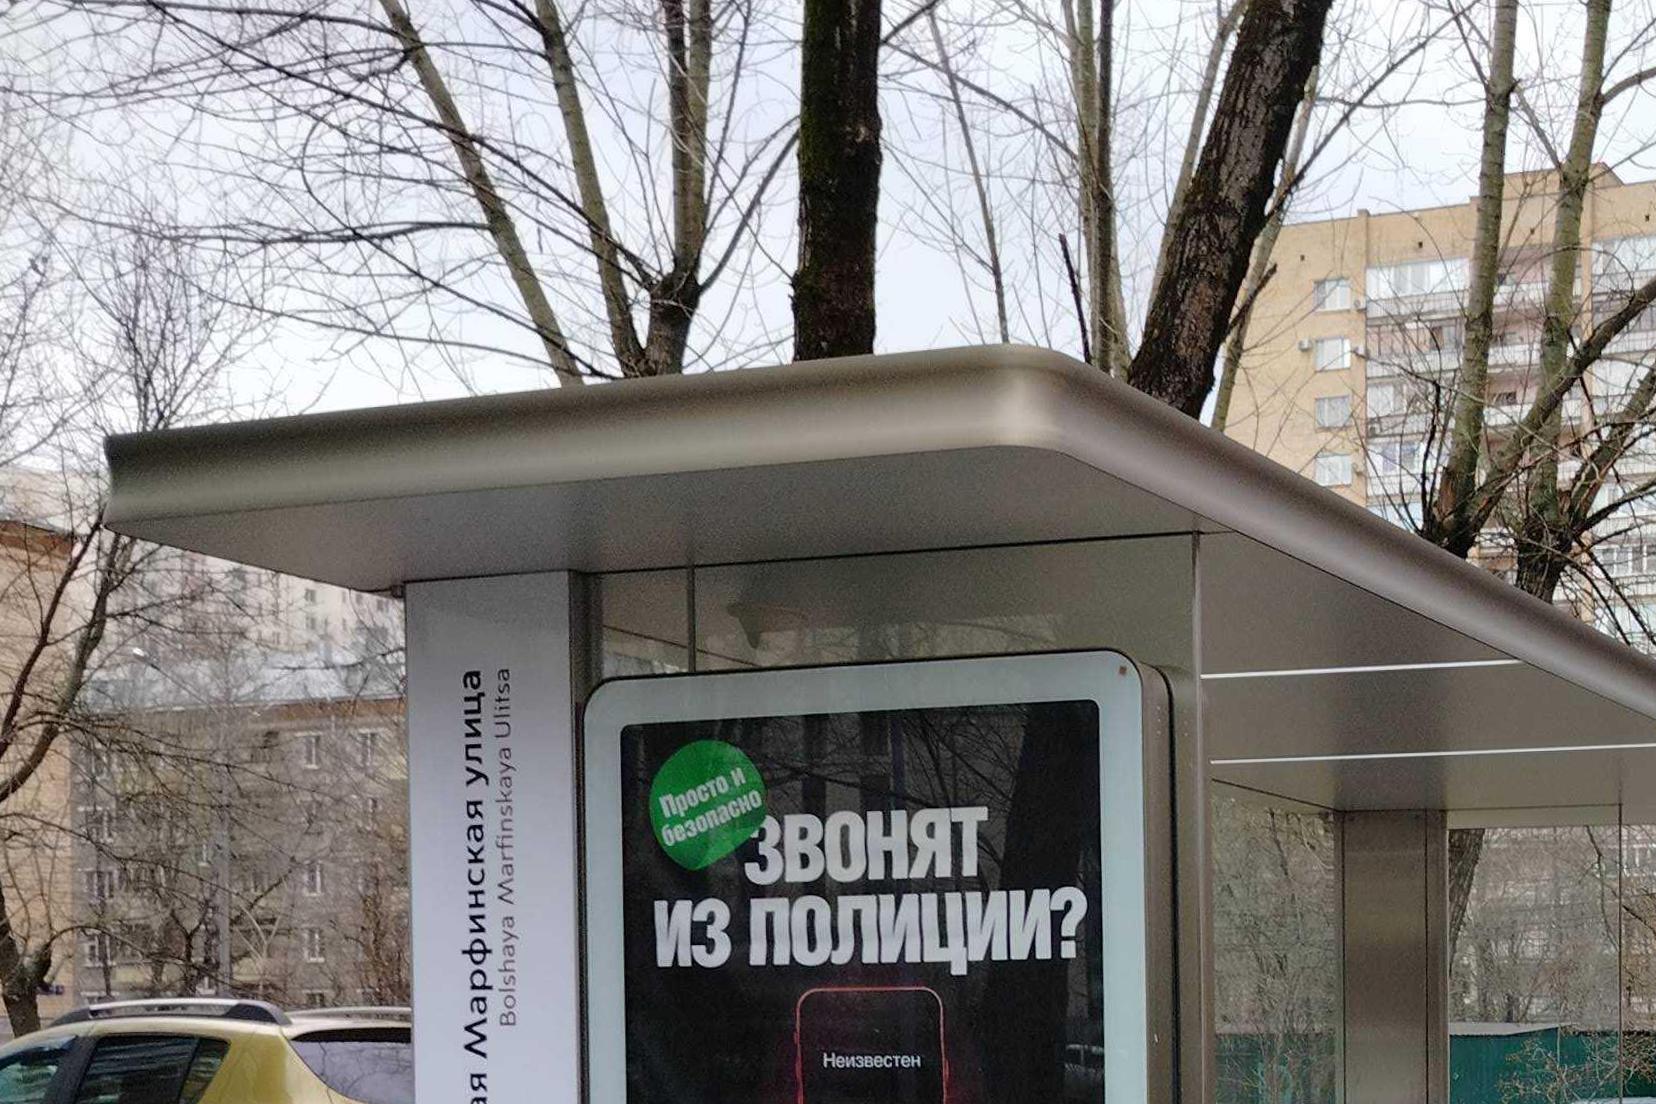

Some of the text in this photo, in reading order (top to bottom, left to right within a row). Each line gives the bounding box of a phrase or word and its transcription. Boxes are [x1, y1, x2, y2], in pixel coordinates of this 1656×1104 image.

[462, 670, 489, 787] улица
[658, 774, 730, 819] Просто
[661, 789, 763, 847] безопасно
[493, 668, 519, 1027] Bolshaya Marfinskaya Ulitsa
[744, 806, 988, 885] ЗВОНЯТ
[461, 799, 493, 1059] Марфинская
[653, 886, 1088, 976] ИЗ ПОЛИЦИИ?
[822, 1052, 922, 1069] Неизвестен
